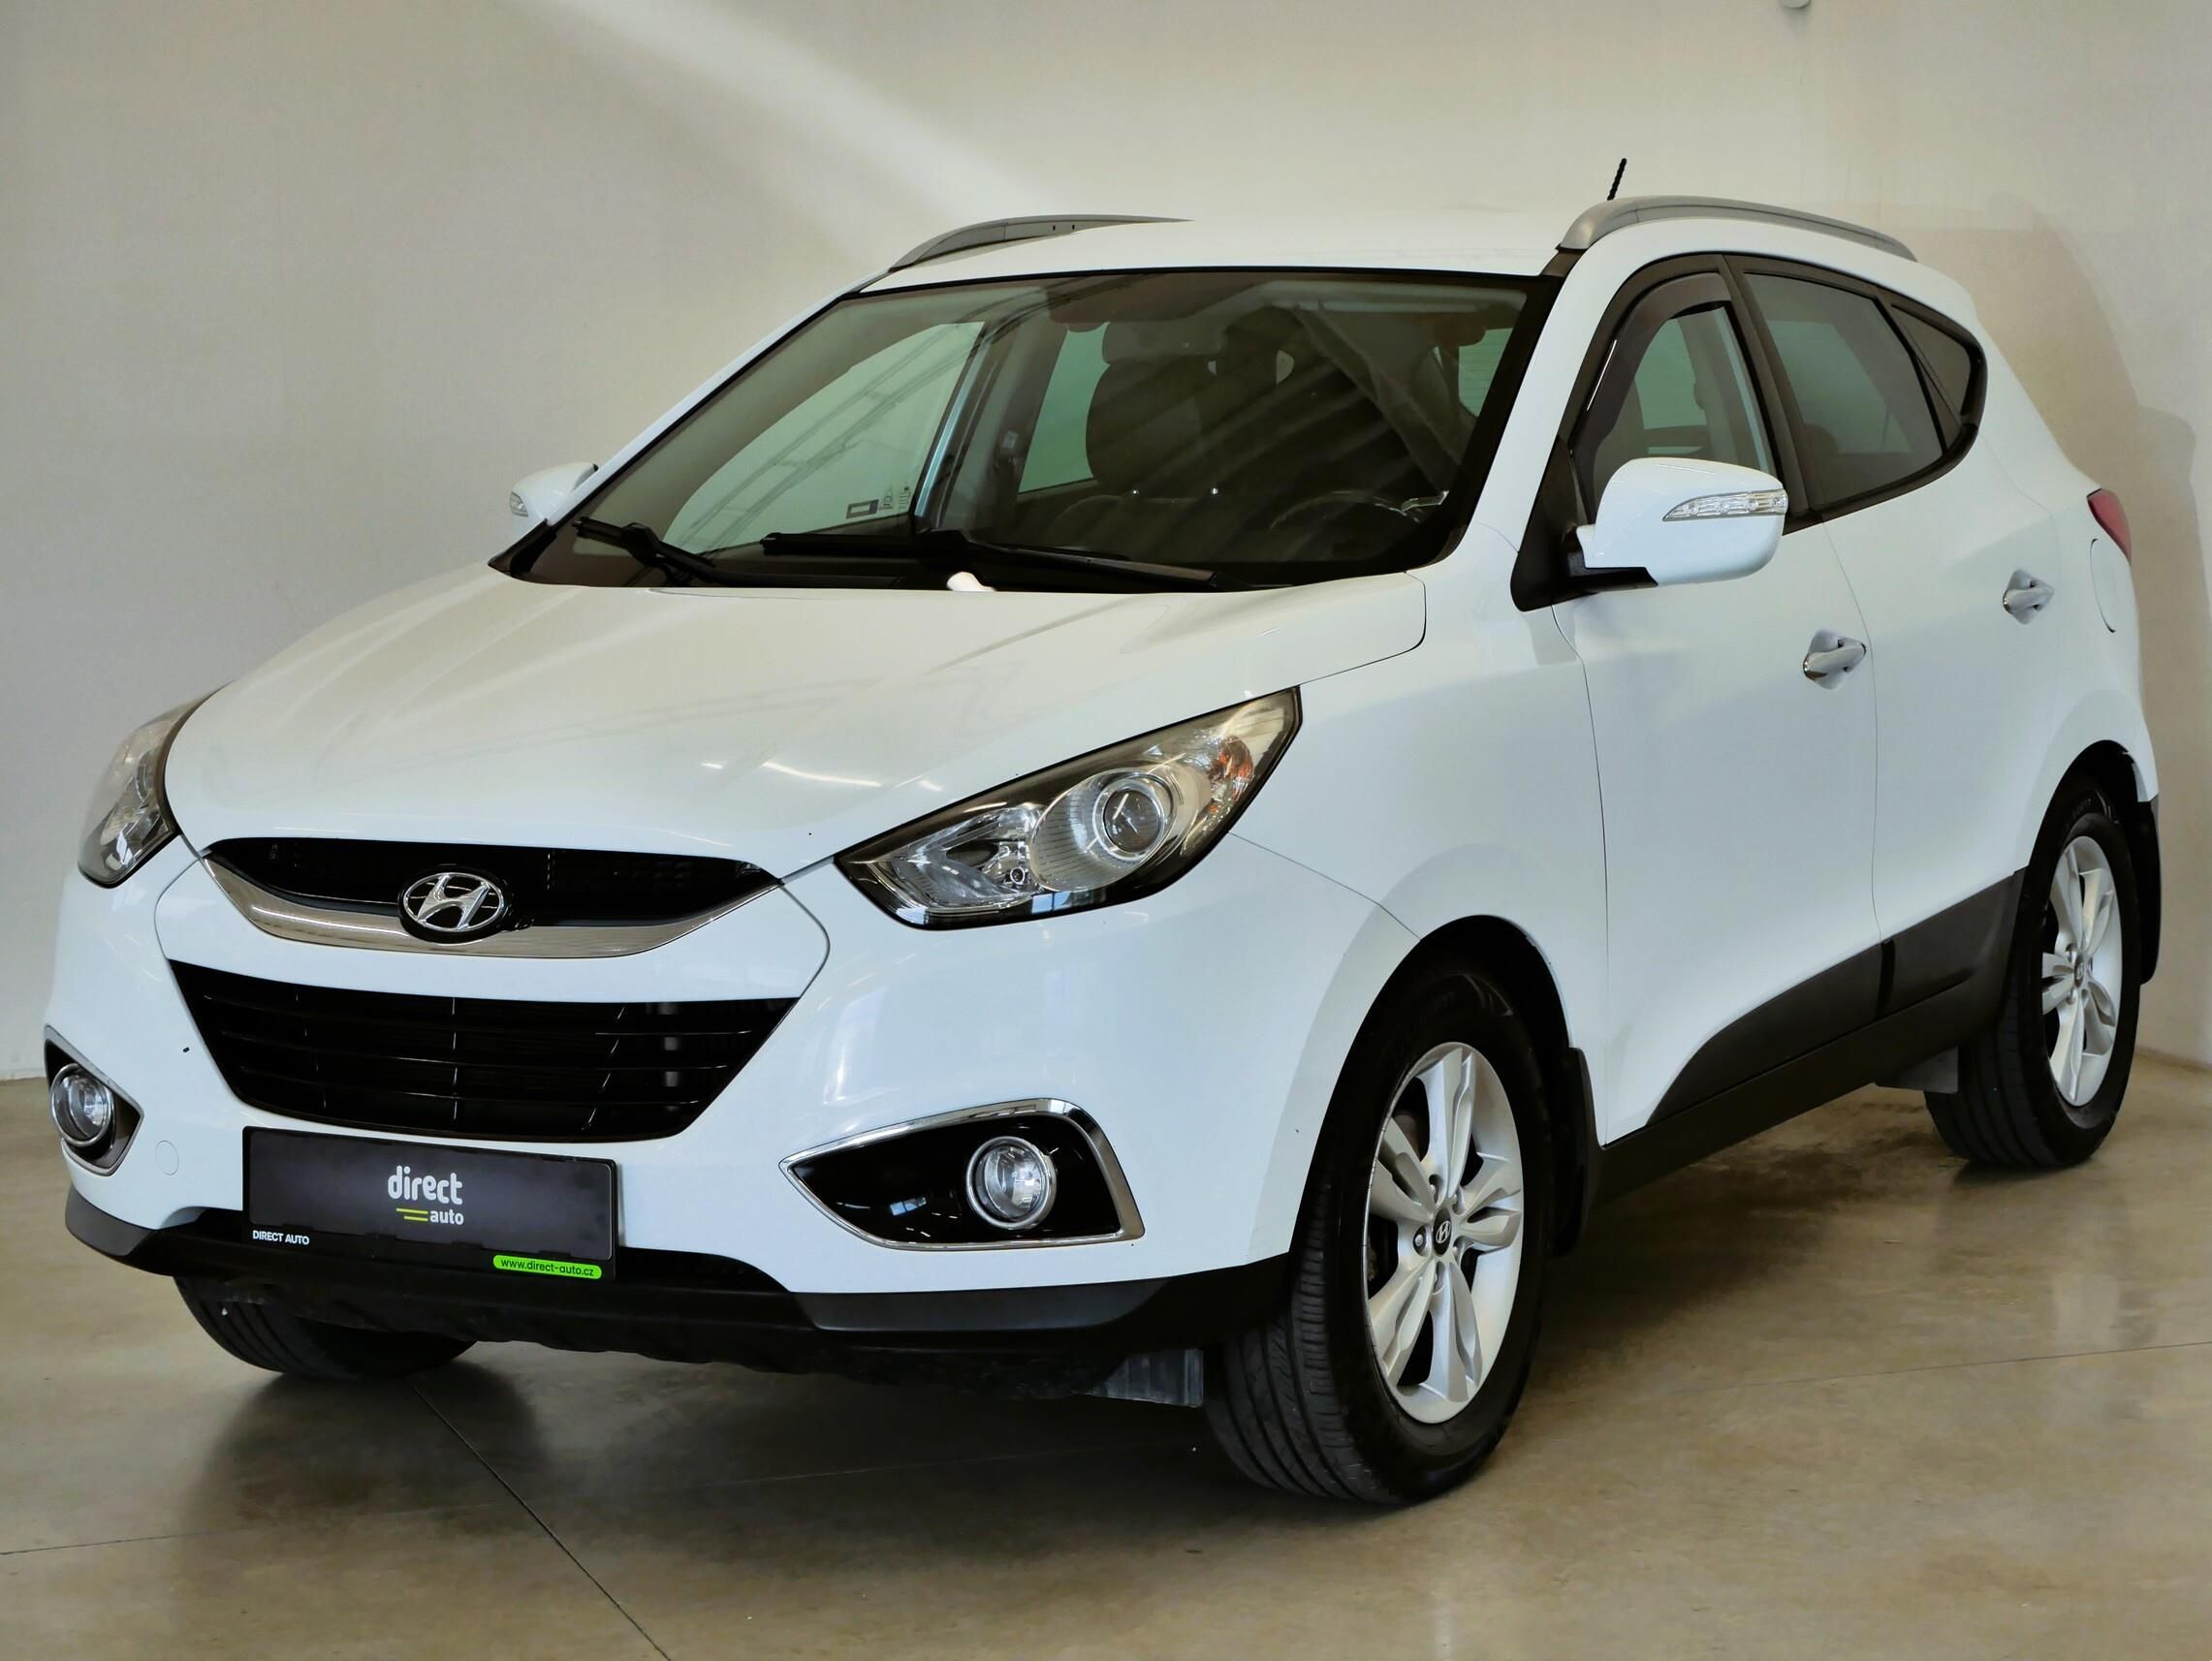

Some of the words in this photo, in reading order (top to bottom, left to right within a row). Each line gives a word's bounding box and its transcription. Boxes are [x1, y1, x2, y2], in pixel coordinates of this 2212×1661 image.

[388, 1165, 463, 1205] direct
[429, 1208, 464, 1225] auto
[252, 1230, 284, 1242] DIRECT
[285, 1234, 310, 1245] AUTO
[500, 1259, 594, 1276] www.direct-auto.cz
